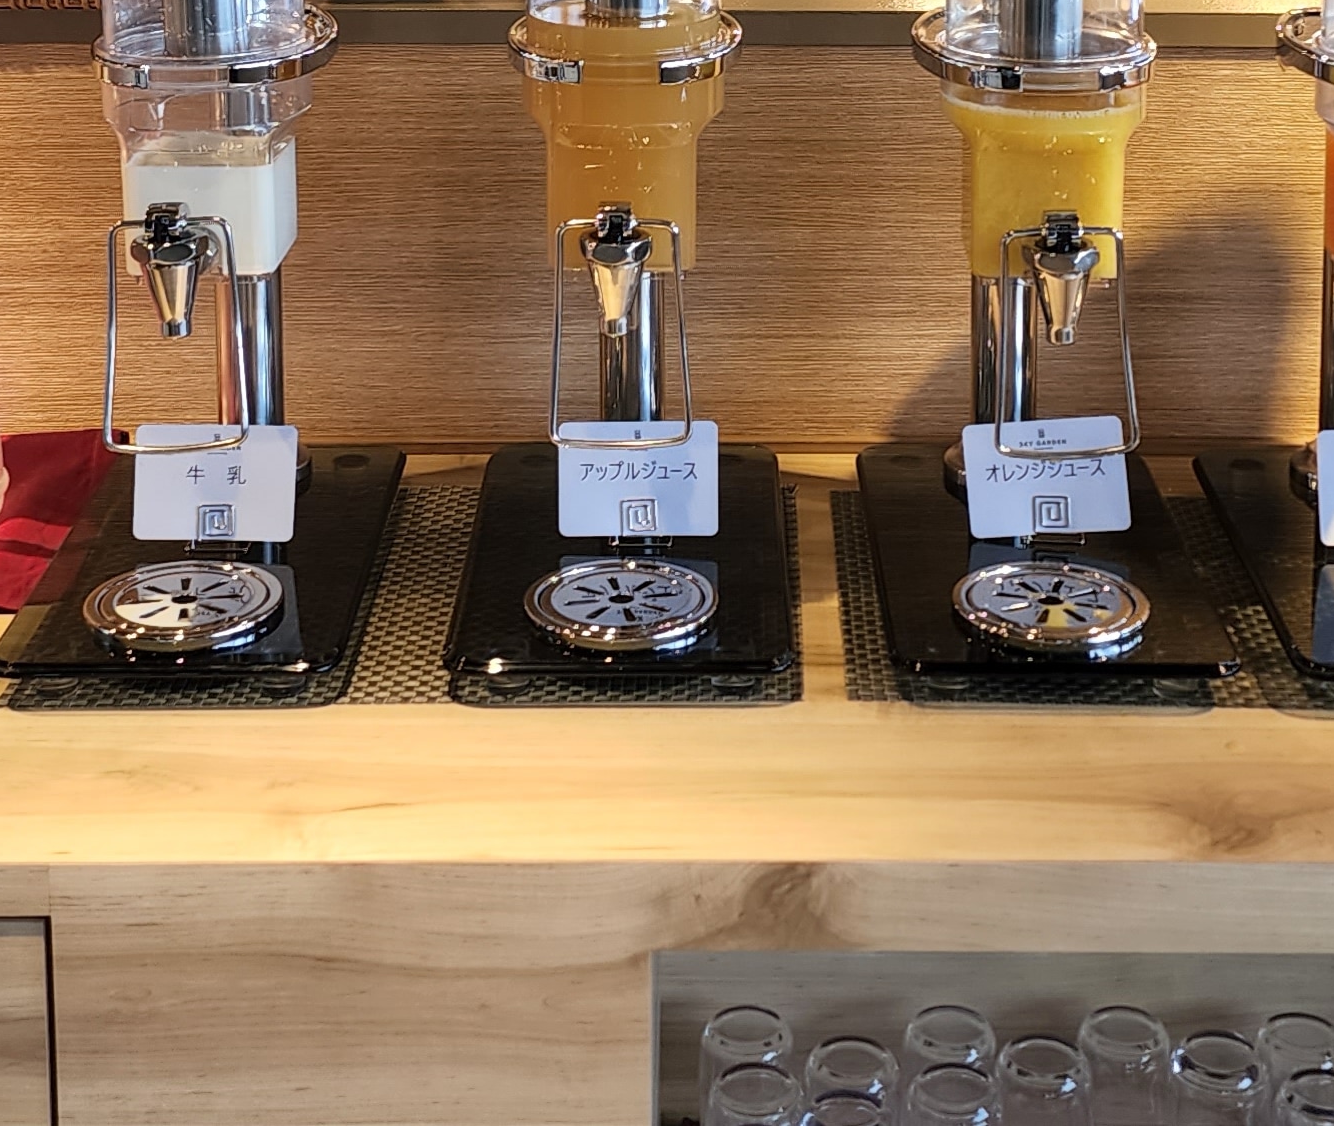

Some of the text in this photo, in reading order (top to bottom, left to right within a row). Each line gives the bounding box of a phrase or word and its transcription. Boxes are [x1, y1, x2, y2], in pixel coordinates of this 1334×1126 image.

[579, 460, 698, 481] アップルジュース
[985, 459, 1106, 483] オレンジジュース
